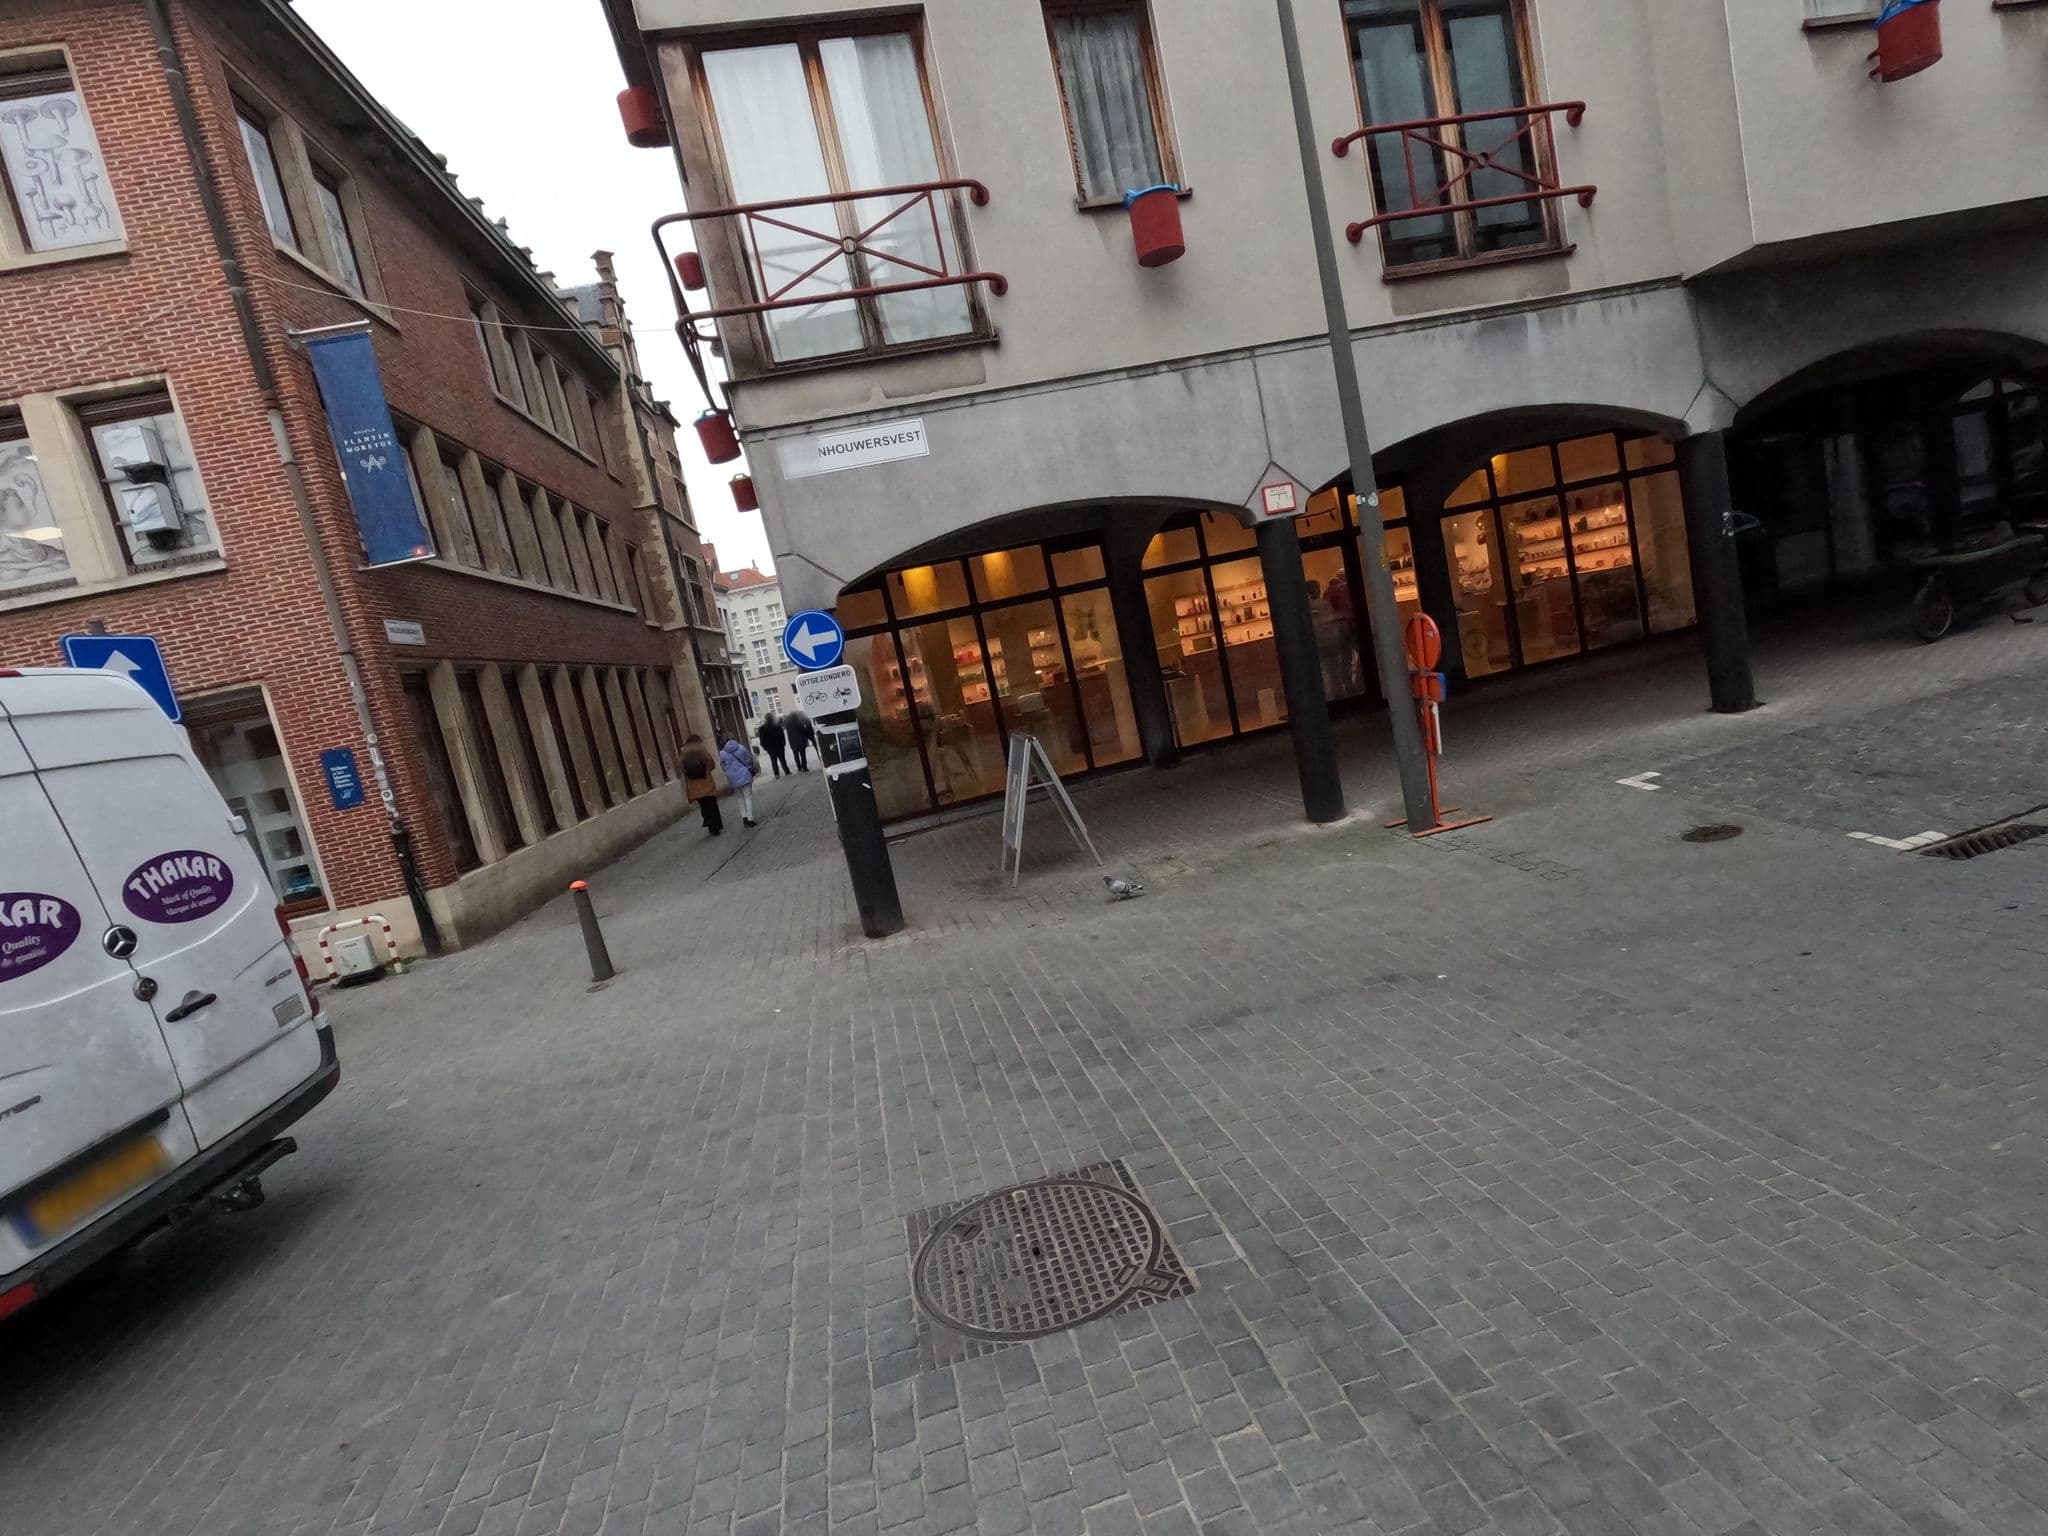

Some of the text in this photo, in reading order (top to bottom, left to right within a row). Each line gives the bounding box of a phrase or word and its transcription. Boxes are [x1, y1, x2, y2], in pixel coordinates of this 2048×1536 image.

[343, 432, 390, 446] PLANTIN
[346, 440, 392, 453] MORETUS
[800, 670, 851, 686] UITGEZONDERD
[128, 856, 223, 900] THAKAR
[2, 936, 41, 955] Quality
